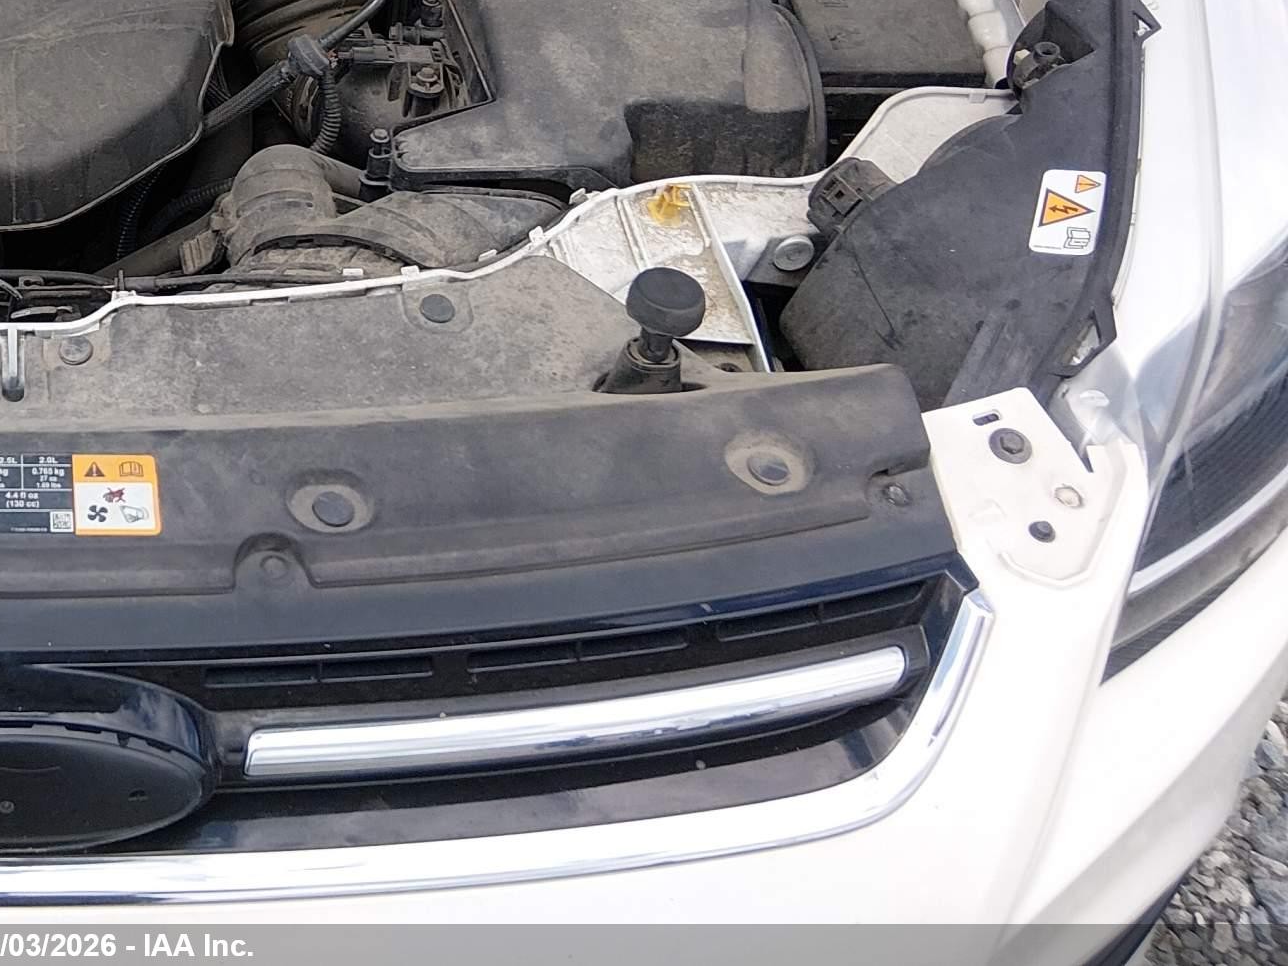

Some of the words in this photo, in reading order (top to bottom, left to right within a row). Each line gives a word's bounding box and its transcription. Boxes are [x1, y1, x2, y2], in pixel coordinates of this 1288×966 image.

[54, 467, 65, 476] kg
[6, 500, 25, 508] (130
[26, 500, 40, 508] cc)
